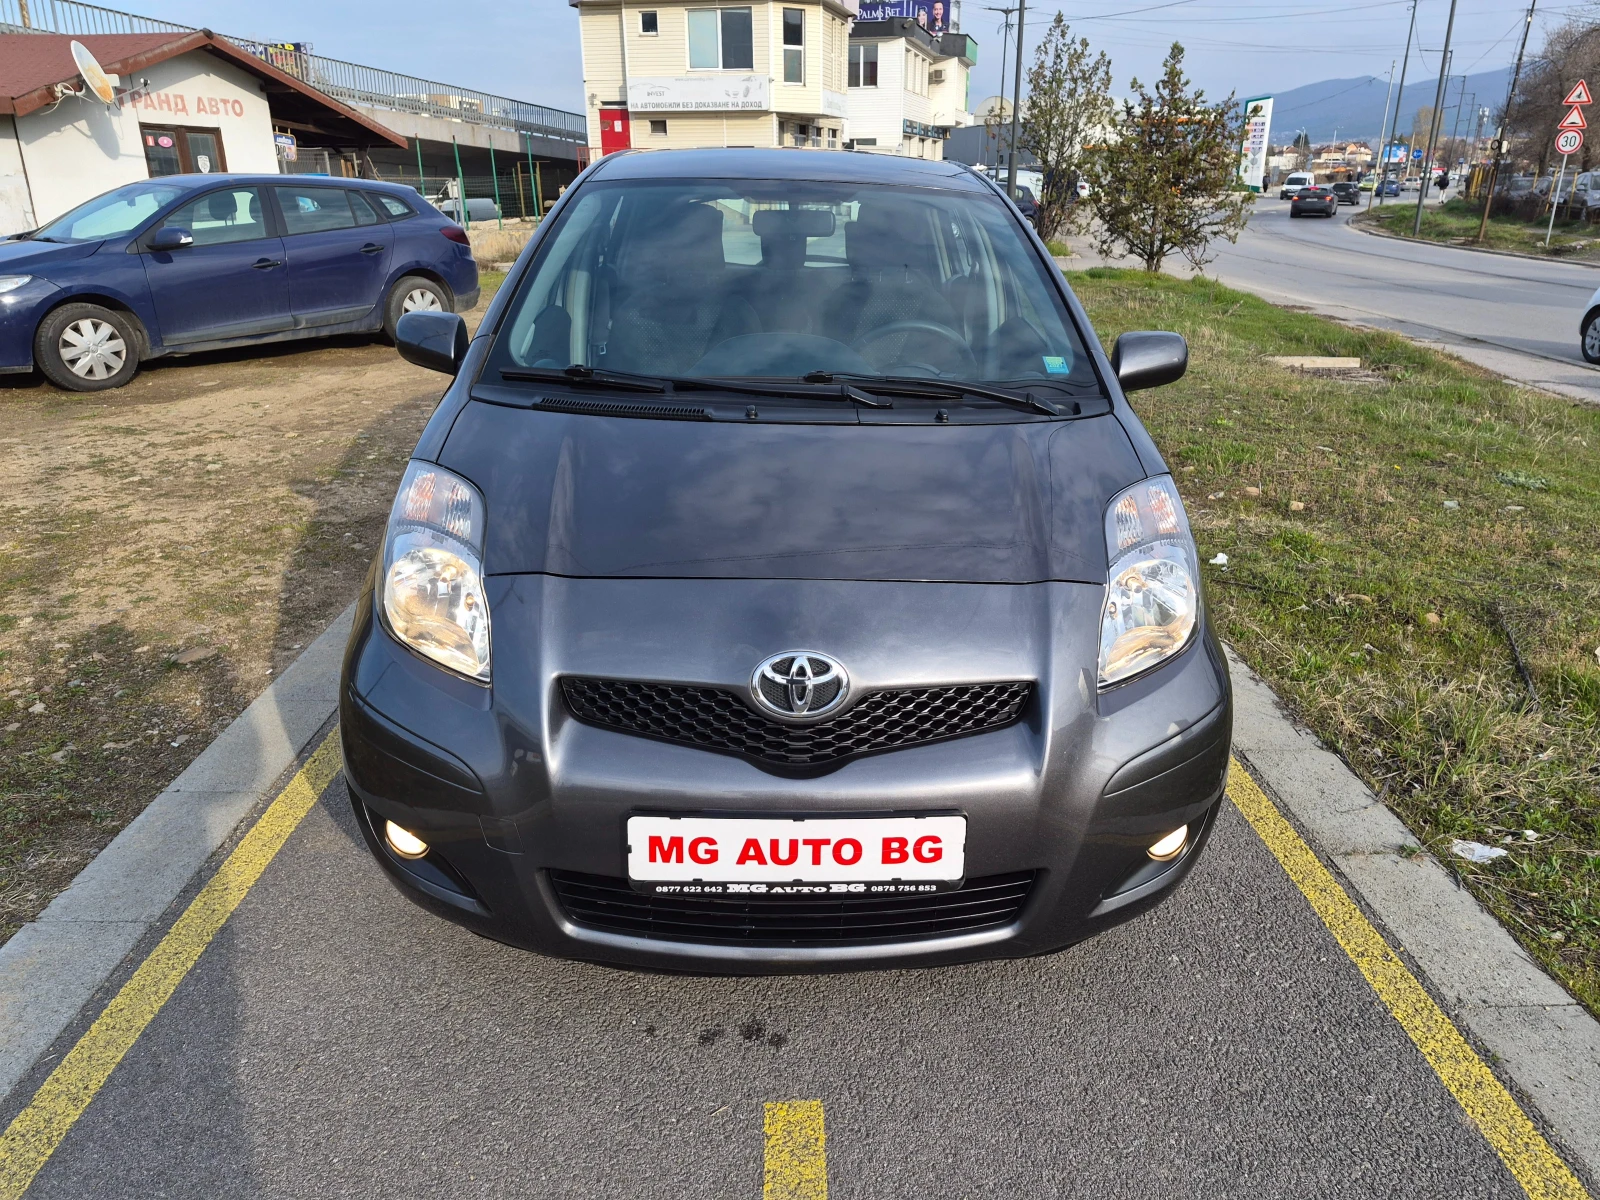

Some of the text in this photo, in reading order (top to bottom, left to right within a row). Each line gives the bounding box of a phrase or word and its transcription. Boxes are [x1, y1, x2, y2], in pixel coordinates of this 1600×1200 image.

[885, 7, 901, 18] BET
[116, 88, 244, 117] ГРАНД АВТО
[682, 101, 693, 109] БЕЗ
[694, 101, 730, 109] ДОКАЗВАНЕ
[741, 100, 762, 109] ДОХОД
[1561, 136, 1577, 148] 30
[648, 835, 943, 866] MG AUTO BG
[655, 885, 681, 893] 0877
[683, 885, 702, 893] 622
[704, 885, 723, 893] 642
[726, 883, 769, 893] MG
[829, 883, 867, 893] BG
[918, 884, 937, 892] 853
